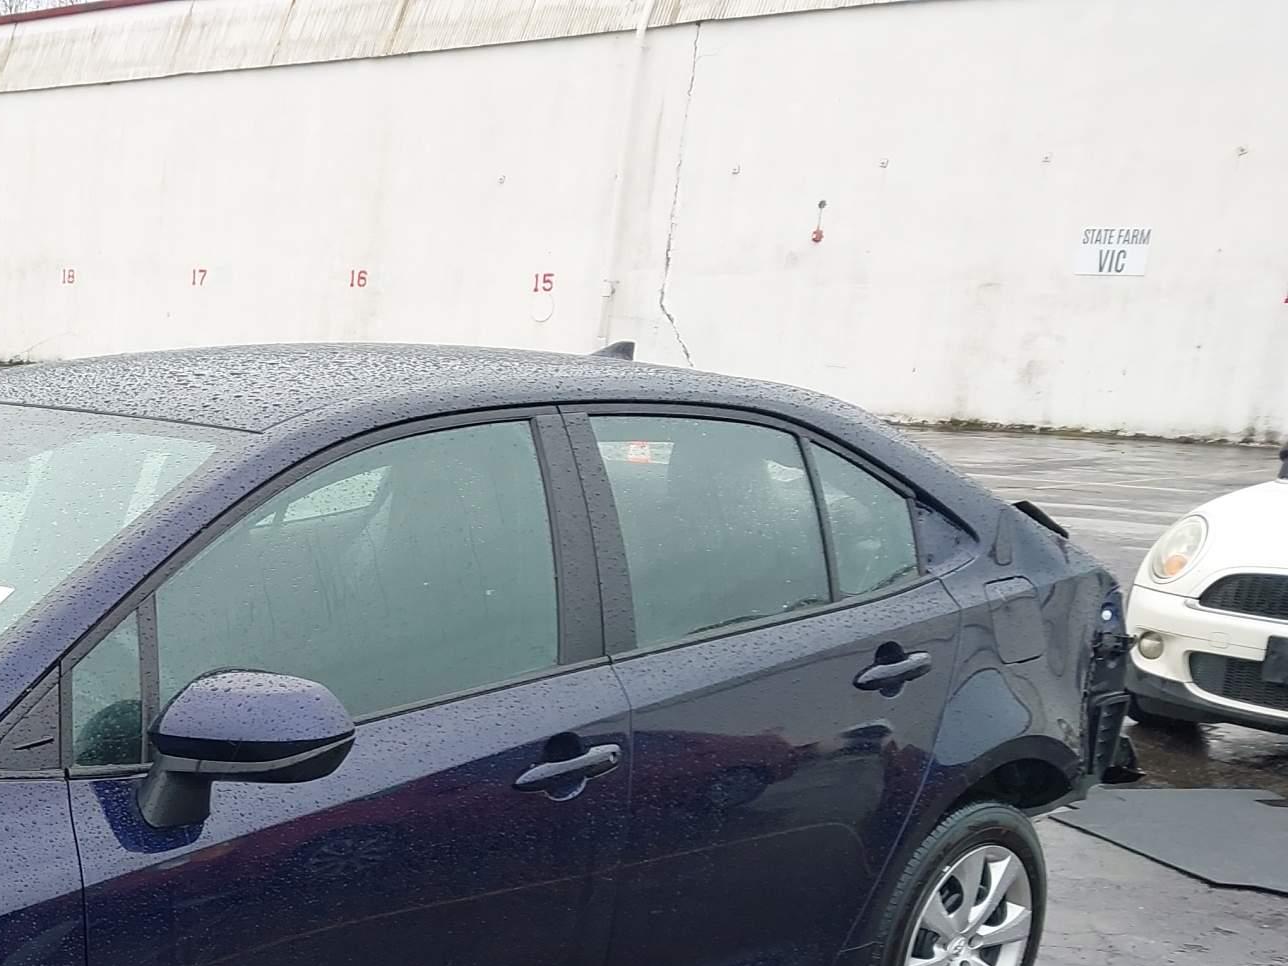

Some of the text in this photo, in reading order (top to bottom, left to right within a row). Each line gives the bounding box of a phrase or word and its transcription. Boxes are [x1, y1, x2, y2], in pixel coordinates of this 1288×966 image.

[1082, 228, 1152, 245] STATE FARM
[1098, 249, 1127, 274] VIC
[62, 269, 76, 284] 18
[191, 269, 208, 286] 17
[349, 270, 368, 288] 16
[533, 273, 555, 292] 15
